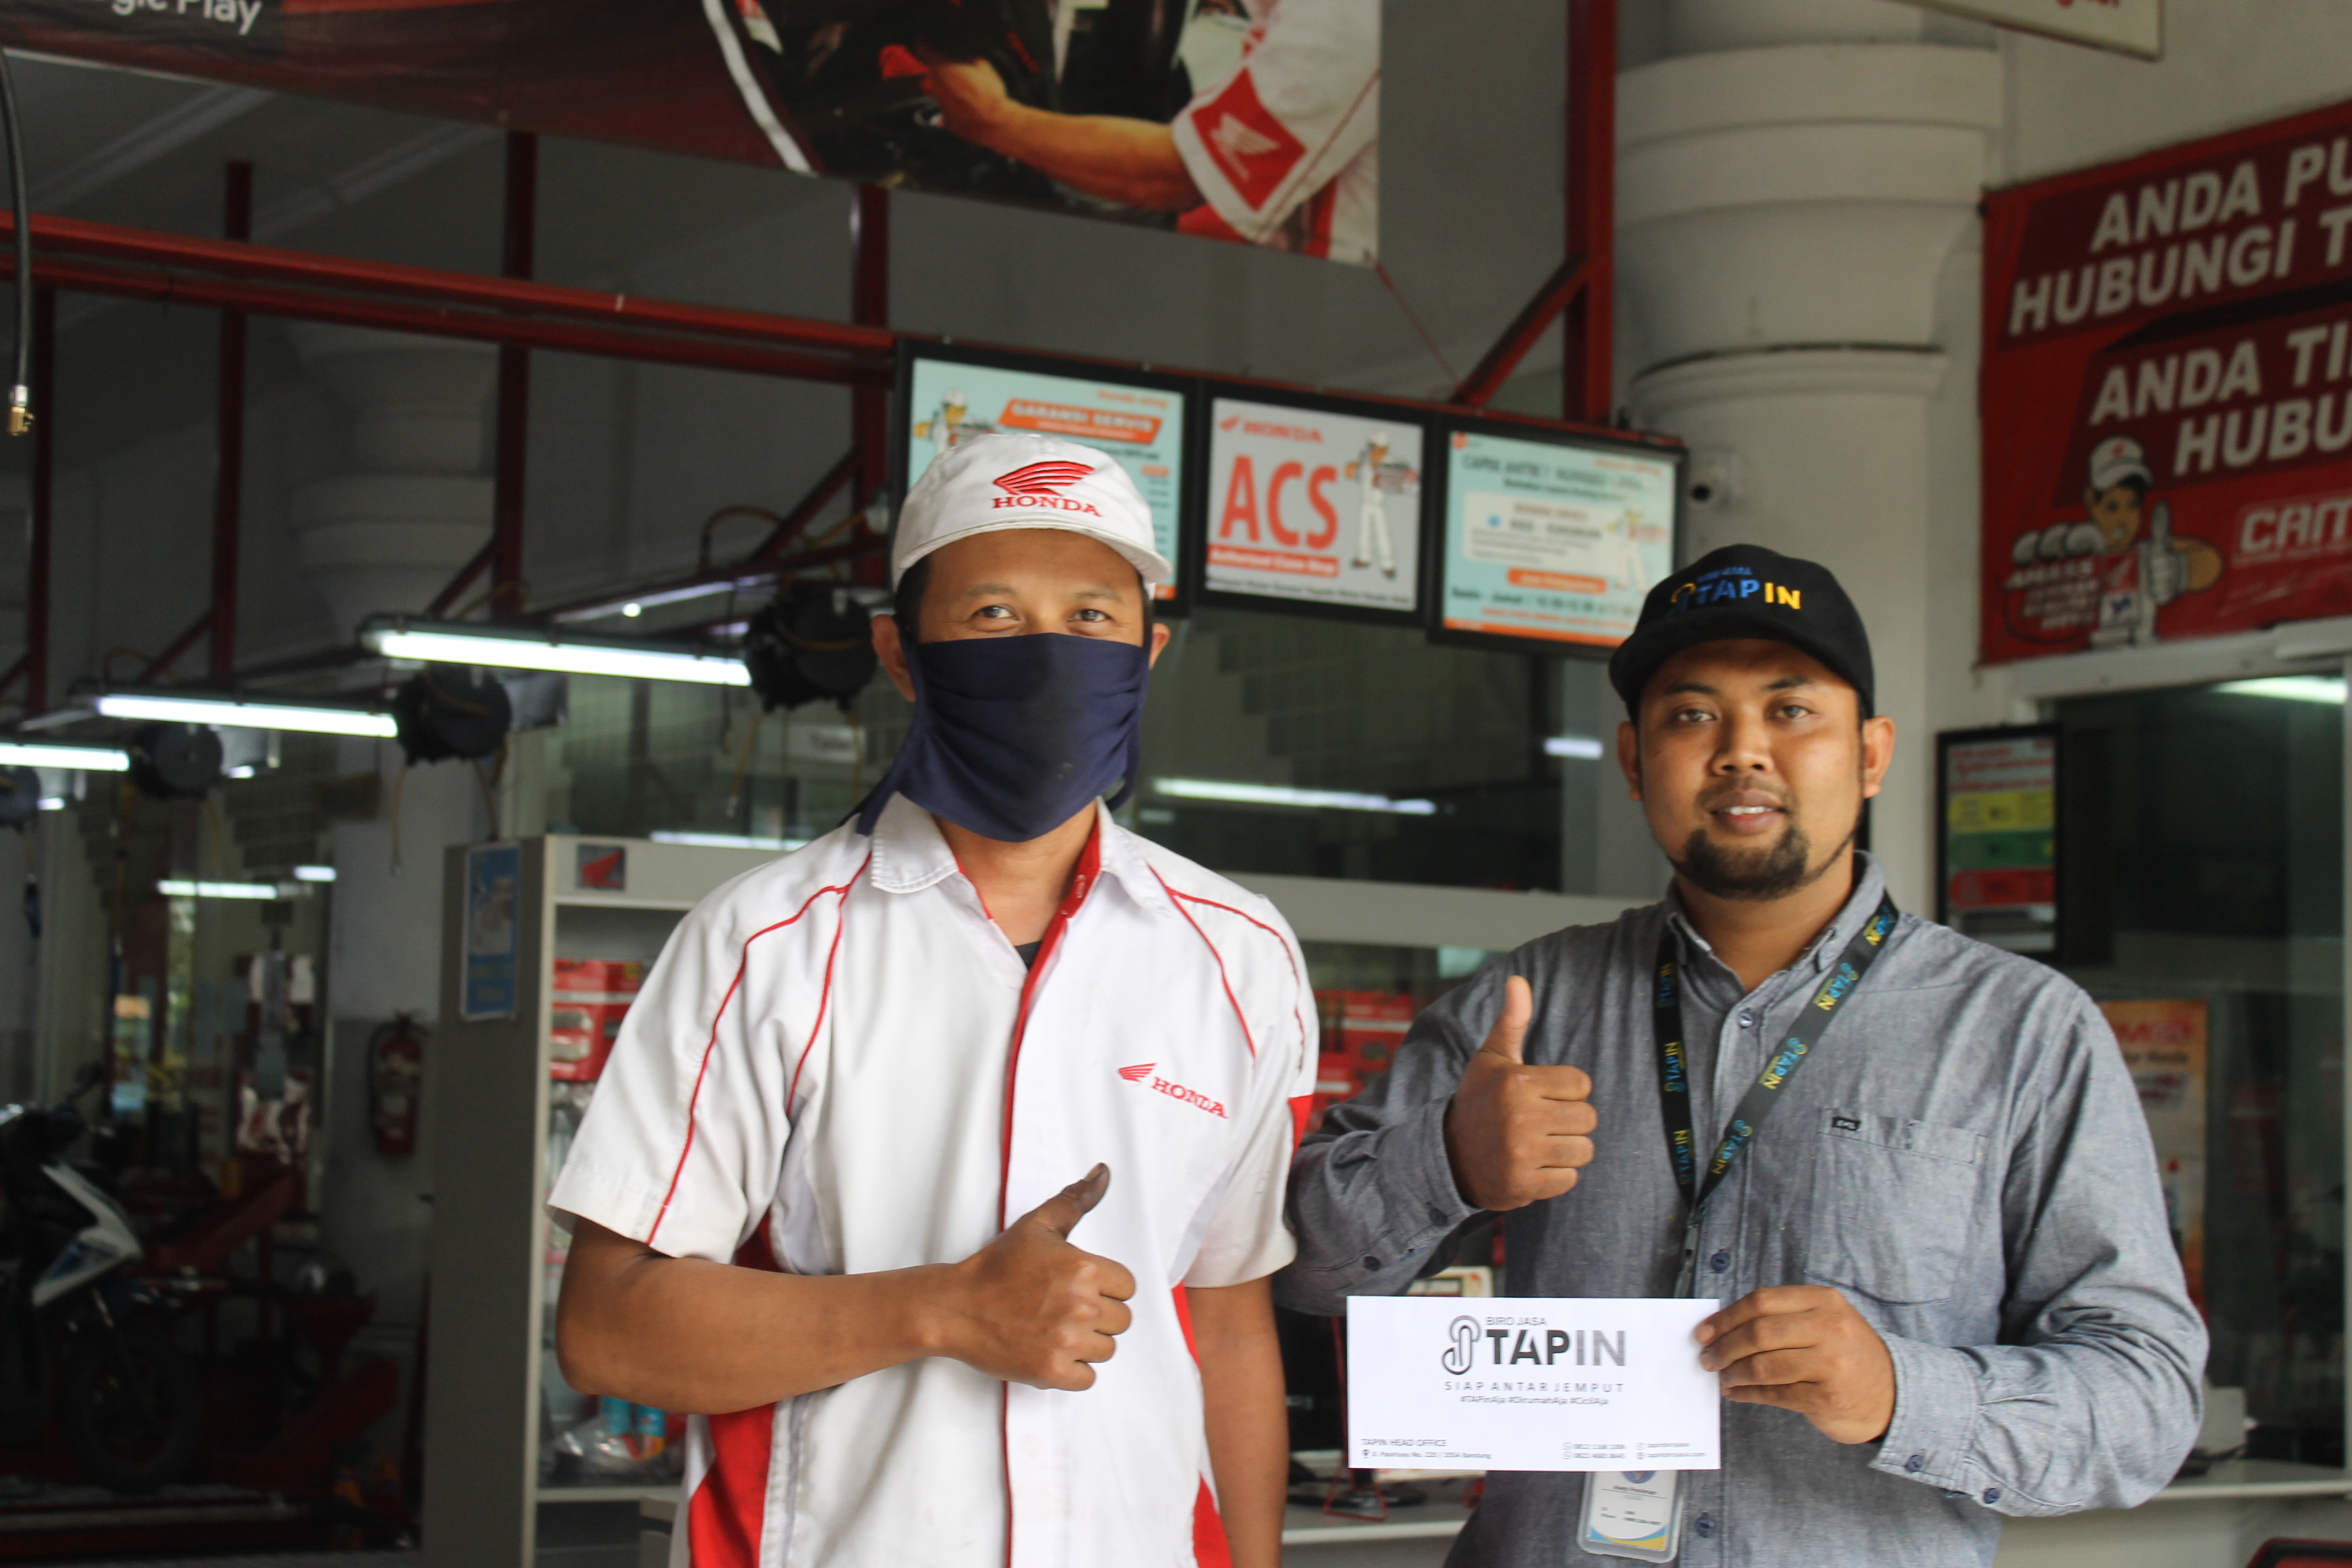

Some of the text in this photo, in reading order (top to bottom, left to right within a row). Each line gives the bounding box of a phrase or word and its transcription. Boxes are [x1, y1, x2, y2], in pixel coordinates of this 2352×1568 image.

[2089, 160, 2263, 253] ANDA
[2008, 219, 2296, 337] HUBUNGI
[2088, 319, 2352, 427] ANDA TI
[992, 496, 1103, 517] HONDA
[1219, 454, 1338, 550] ACS
[1696, 579, 1801, 609] TAPIN
[1817, 974, 1852, 1011] TAPIN
[1763, 1051, 1799, 1090] TAPIN
[1151, 1076, 1228, 1119] HONDA
[1713, 1135, 1745, 1174] TAPIN
[1485, 1317, 1547, 1326] BIRO JASA
[1486, 1329, 1626, 1366] TAPIN
[1444, 1381, 1625, 1393] SIAP ANTAR JEMPUT
